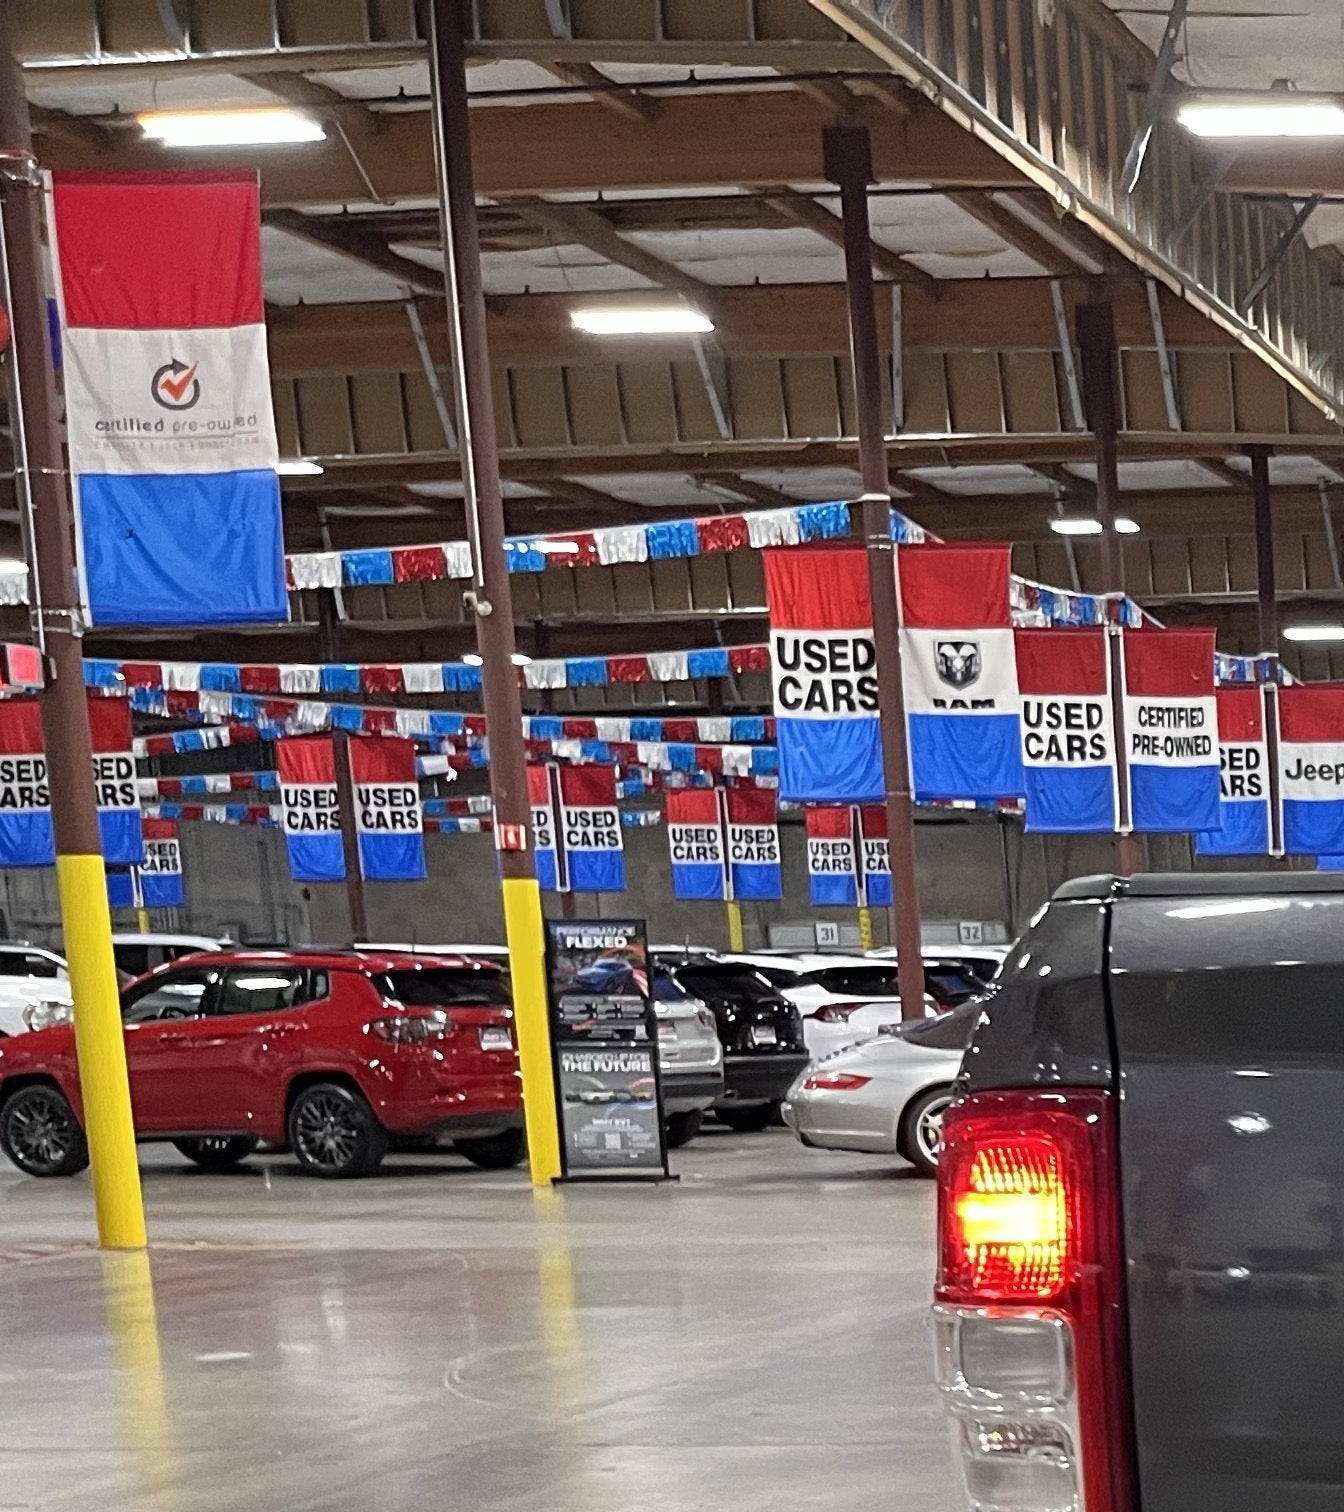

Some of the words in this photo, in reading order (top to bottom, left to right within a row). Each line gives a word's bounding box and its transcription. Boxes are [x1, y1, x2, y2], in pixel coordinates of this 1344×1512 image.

[776, 637, 876, 673] USED
[778, 676, 879, 712] CARS
[933, 698, 996, 710] RAM
[1023, 701, 1103, 730] USED
[1139, 705, 1205, 728] CERTIFIED
[1024, 733, 1107, 761] CARS
[1132, 734, 1211, 757] PRE-OWNED
[0, 760, 46, 783] SED
[0, 785, 50, 808] ARS
[284, 788, 339, 808] USED
[359, 788, 416, 808] USED
[287, 811, 340, 830] CARS
[361, 810, 418, 830] CARS
[566, 811, 616, 828] USED
[567, 830, 619, 847] CARS
[672, 828, 718, 844] USED
[731, 828, 776, 845] USED
[673, 845, 720, 861] CARS
[732, 845, 777, 861] CARS
[810, 842, 850, 856] USED
[811, 857, 852, 871] CARS
[820, 927, 835, 940] 31
[962, 926, 980, 940] 32
[566, 936, 628, 949] FLEXED
[593, 1060, 651, 1072] FUTURE
